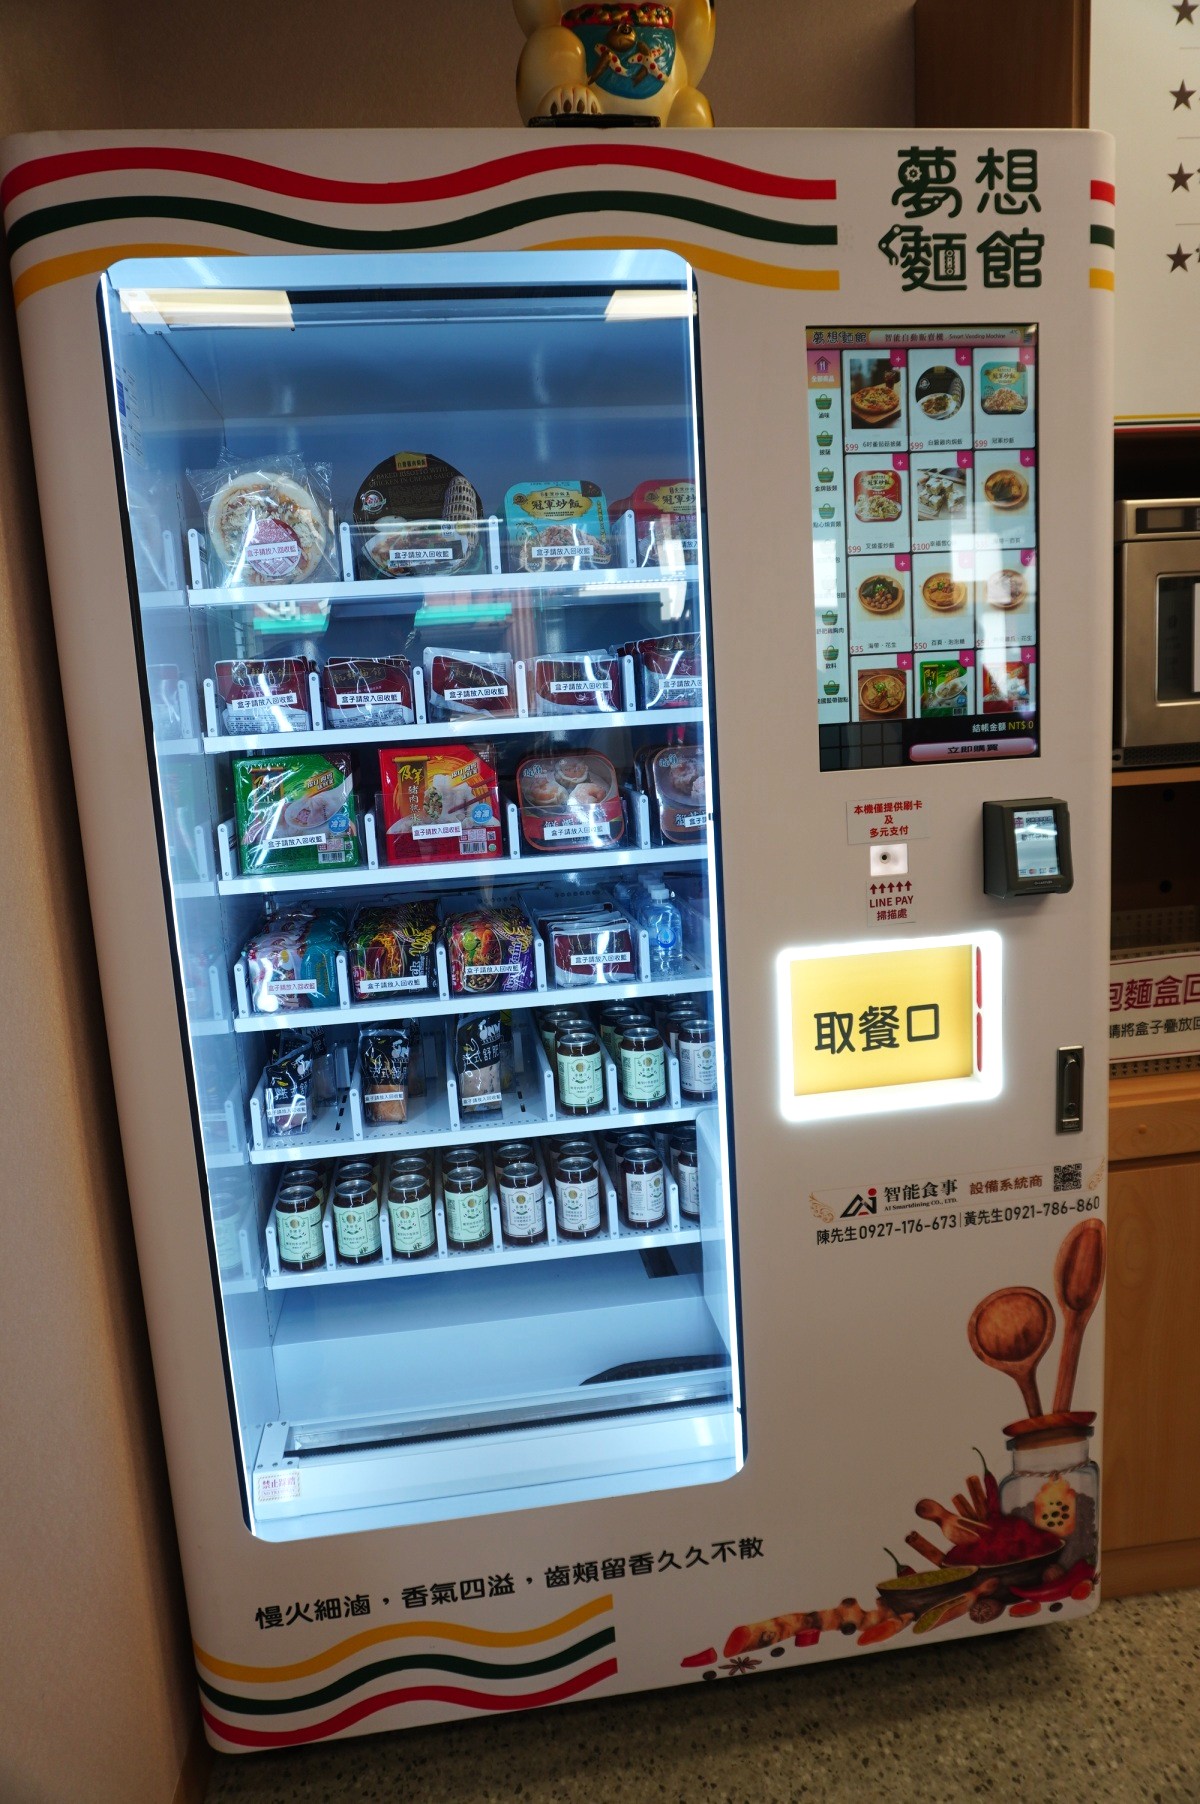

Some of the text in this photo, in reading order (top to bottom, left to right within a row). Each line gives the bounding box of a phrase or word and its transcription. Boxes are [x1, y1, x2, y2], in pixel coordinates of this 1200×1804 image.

[892, 146, 1042, 218] 夢想
[878, 223, 1045, 292] 麵館
[845, 443, 859, 451] $99
[910, 442, 924, 450] $99
[974, 440, 988, 448] $99
[531, 499, 583, 511] 冠軍炒飯
[914, 642, 928, 650] $50
[972, 722, 1007, 733] 結帳金額
[947, 744, 999, 755] 立即購買
[853, 799, 924, 816] 本機僅提供刷卡
[884, 815, 894, 825] 及
[869, 825, 910, 838] 多元支付
[869, 895, 915, 909] LINE PAY
[876, 908, 908, 921] 掃描處
[813, 1003, 940, 1055] 取餐口
[884, 1175, 1044, 1203] 智能食事 設備系統商
